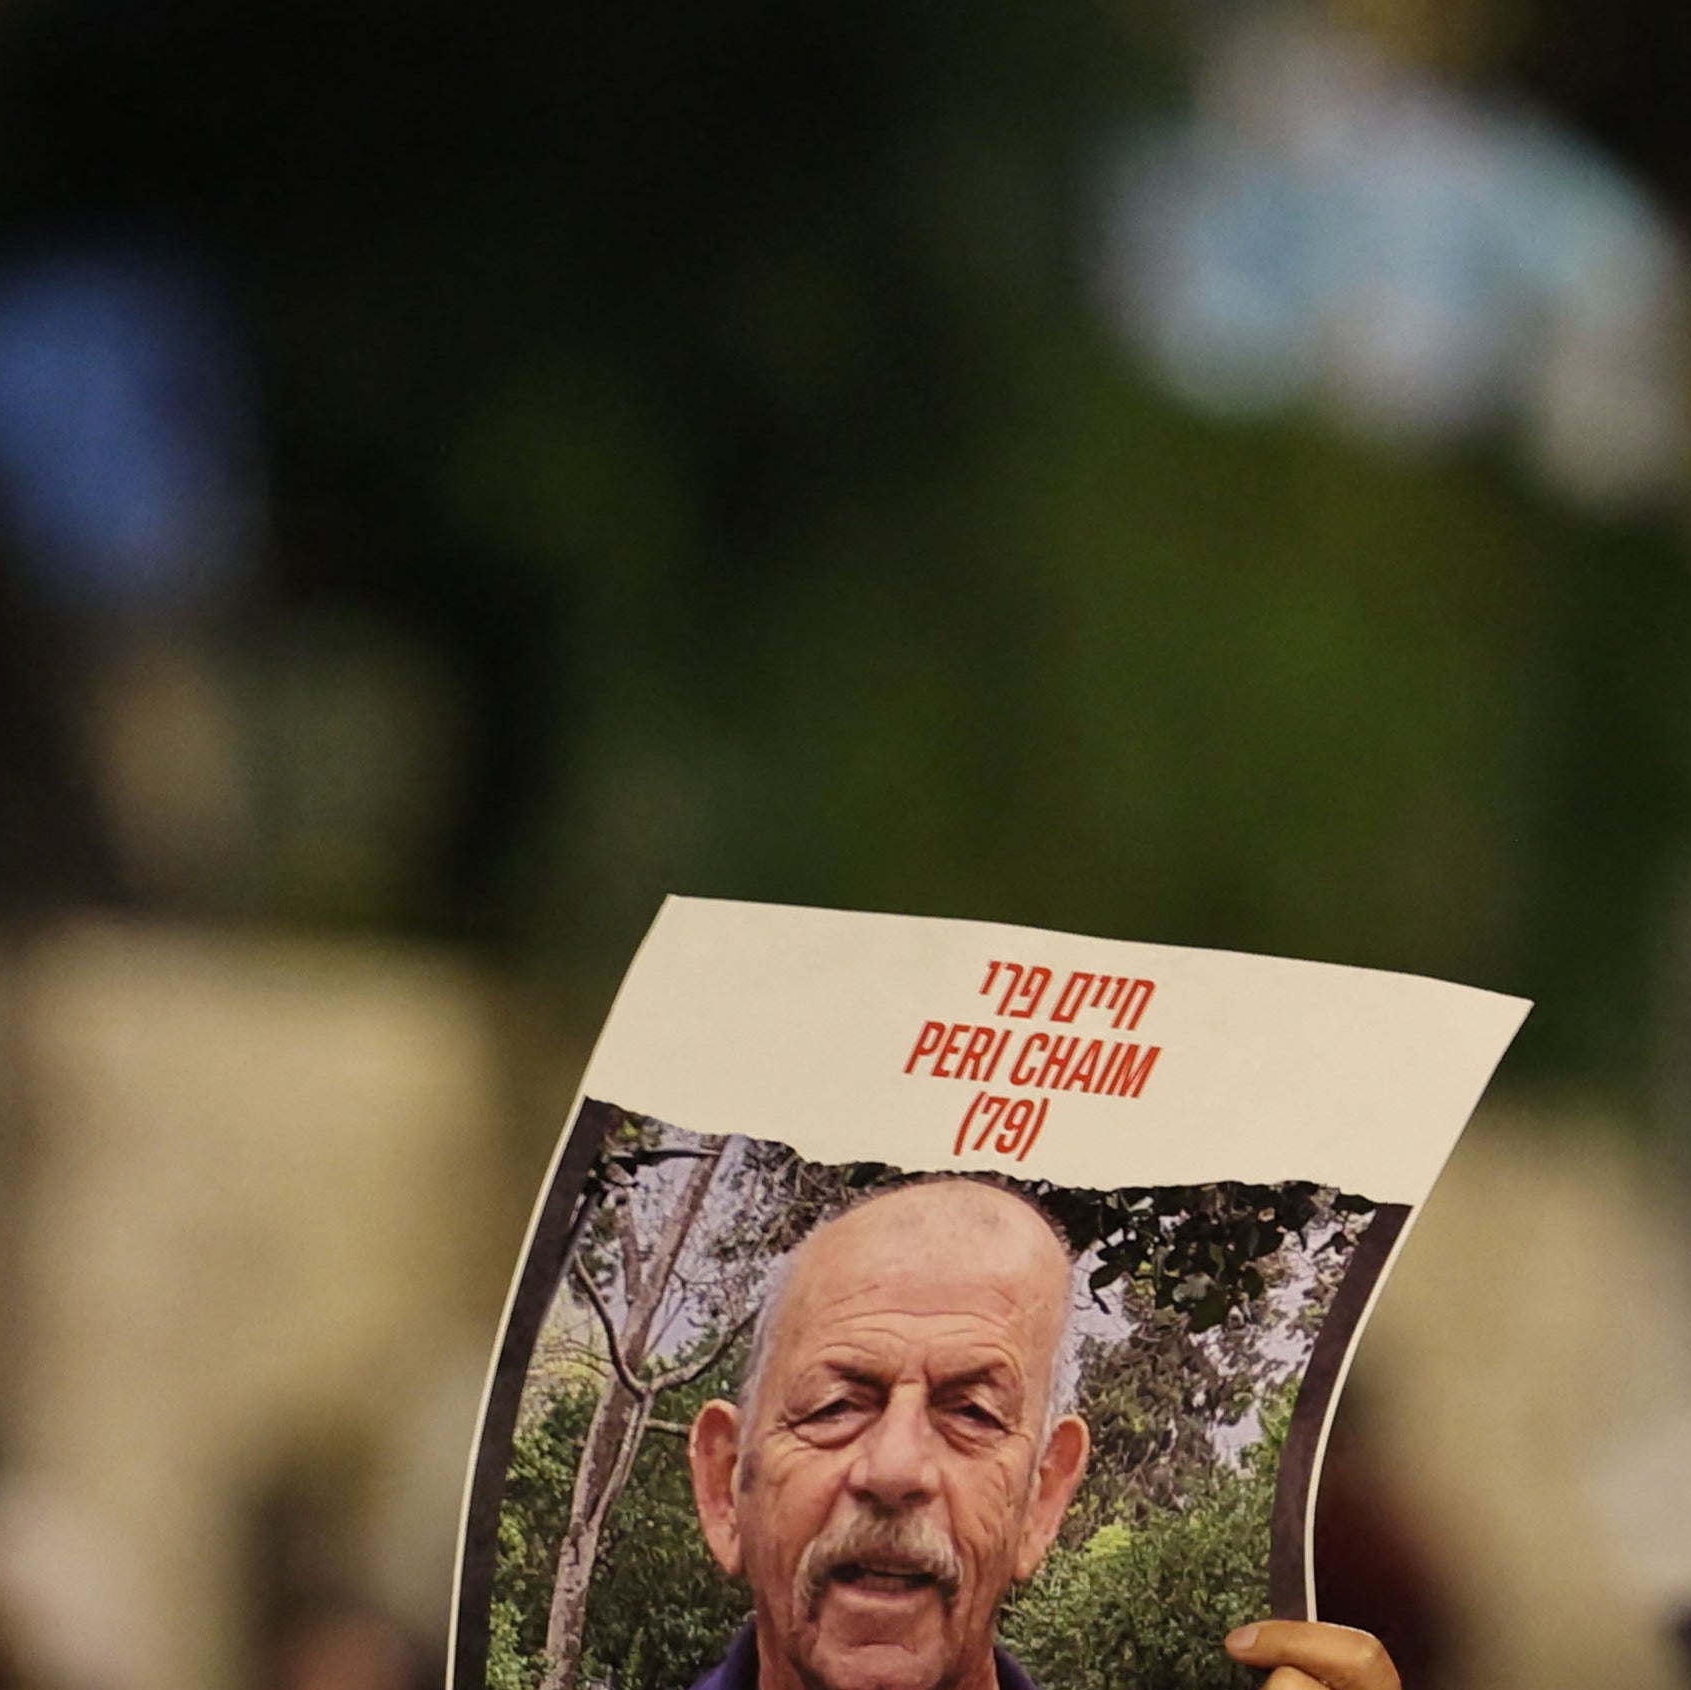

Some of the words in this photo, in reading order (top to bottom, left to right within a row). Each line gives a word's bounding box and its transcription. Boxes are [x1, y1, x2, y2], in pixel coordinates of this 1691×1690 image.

[979, 960, 1052, 1019] פרי
[1050, 971, 1155, 1031] חיים
[902, 1020, 1013, 1083] PERI
[1009, 1032, 1163, 1099] CHAIM
[951, 1090, 1050, 1162] (79)
